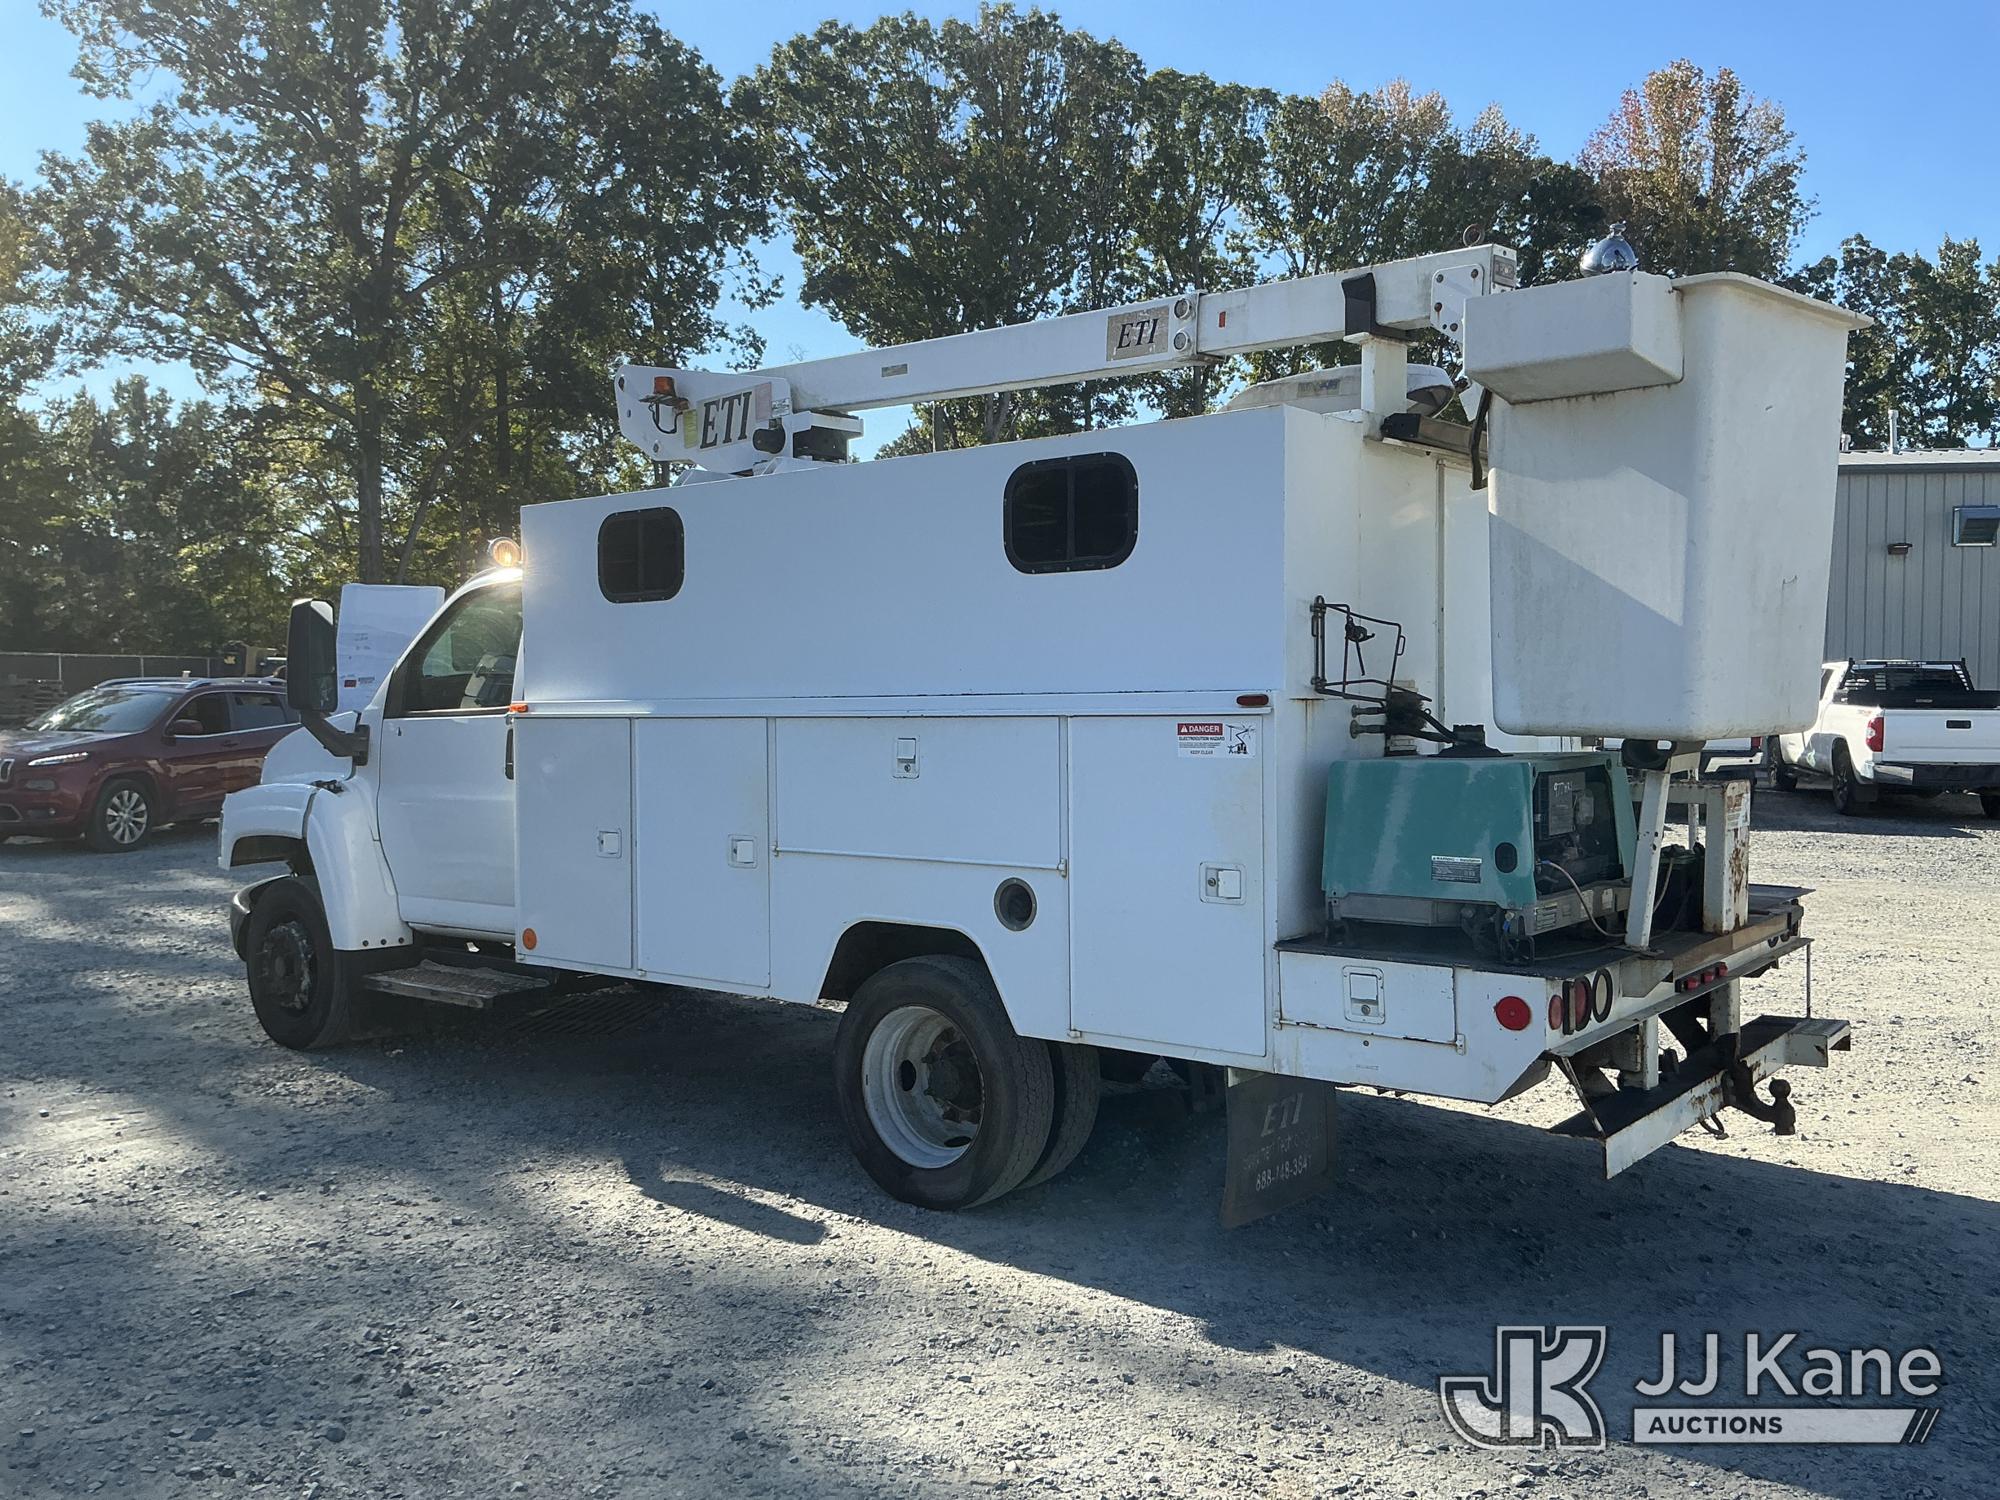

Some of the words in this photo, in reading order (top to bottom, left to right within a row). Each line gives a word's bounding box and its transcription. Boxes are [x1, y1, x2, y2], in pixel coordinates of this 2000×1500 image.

[1116, 318, 1160, 349] ETI
[699, 391, 752, 449] ETI
[1188, 725, 1220, 733] DANGER
[1260, 1092, 1303, 1137] ETI
